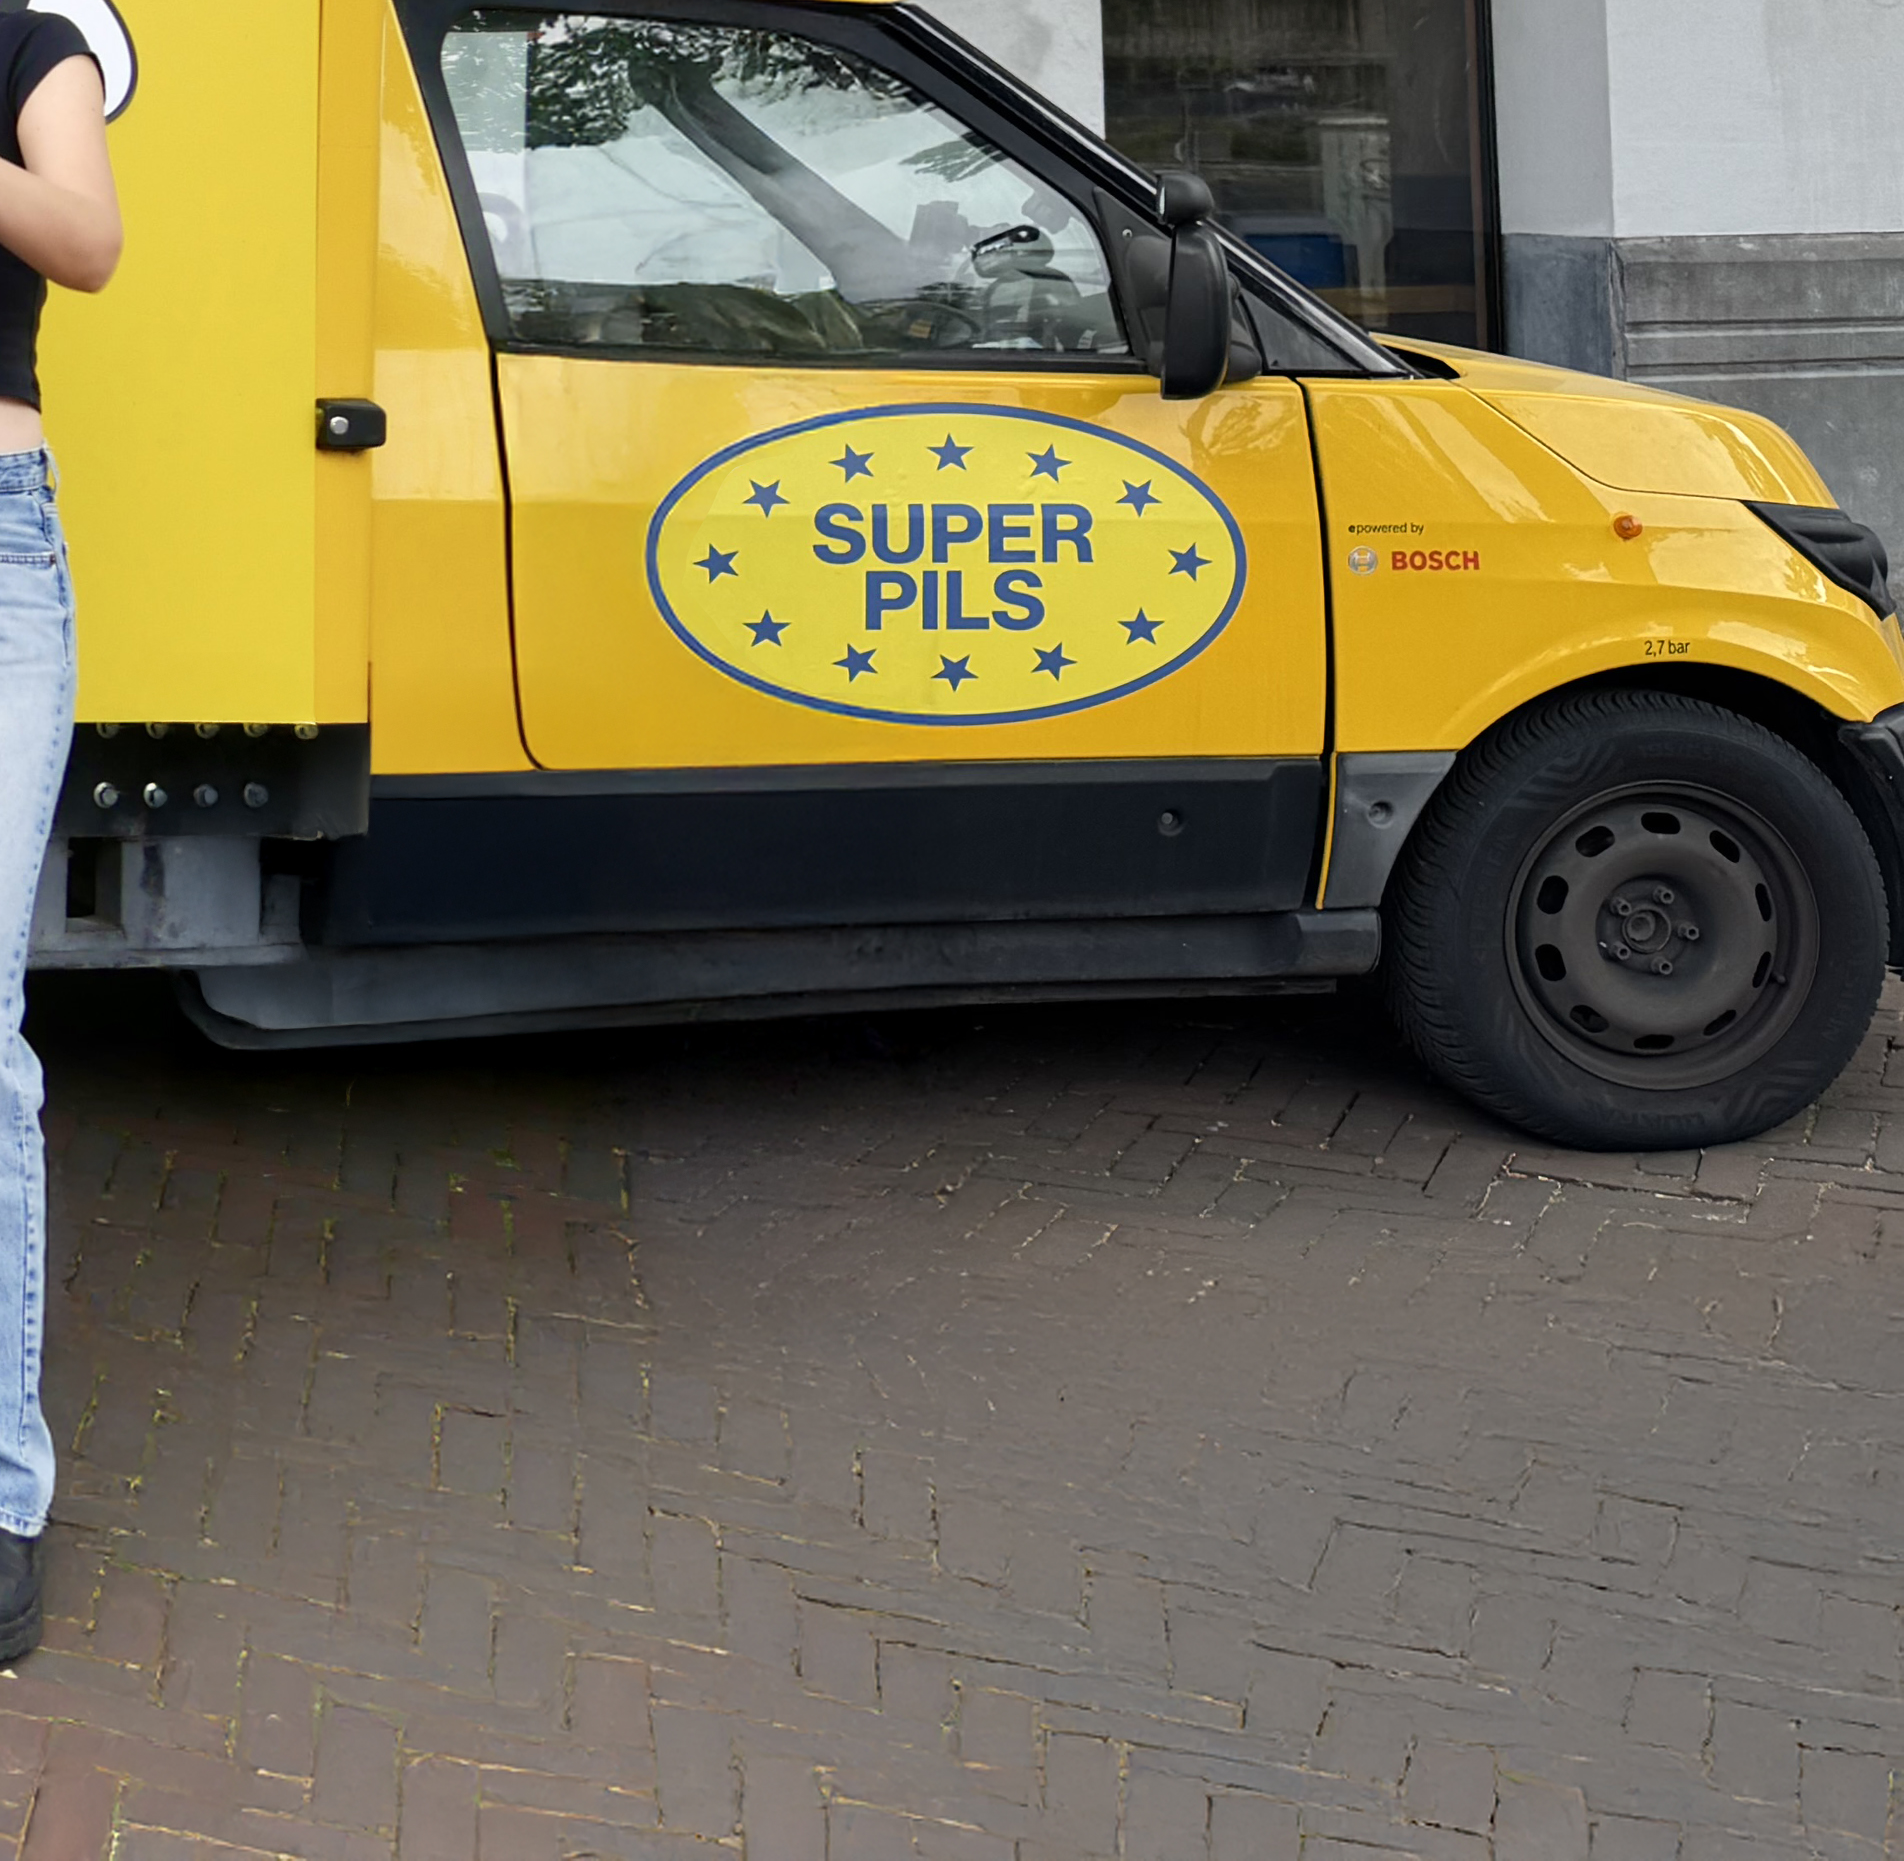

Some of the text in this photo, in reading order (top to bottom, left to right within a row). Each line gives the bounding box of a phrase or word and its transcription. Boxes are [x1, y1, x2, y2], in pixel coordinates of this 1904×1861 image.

[812, 502, 1094, 564] SUPER
[1410, 522, 1425, 536] by
[1391, 550, 1480, 571] BOSCH
[865, 569, 1045, 631] PILS
[1644, 639, 1691, 657] 2,7 bar
